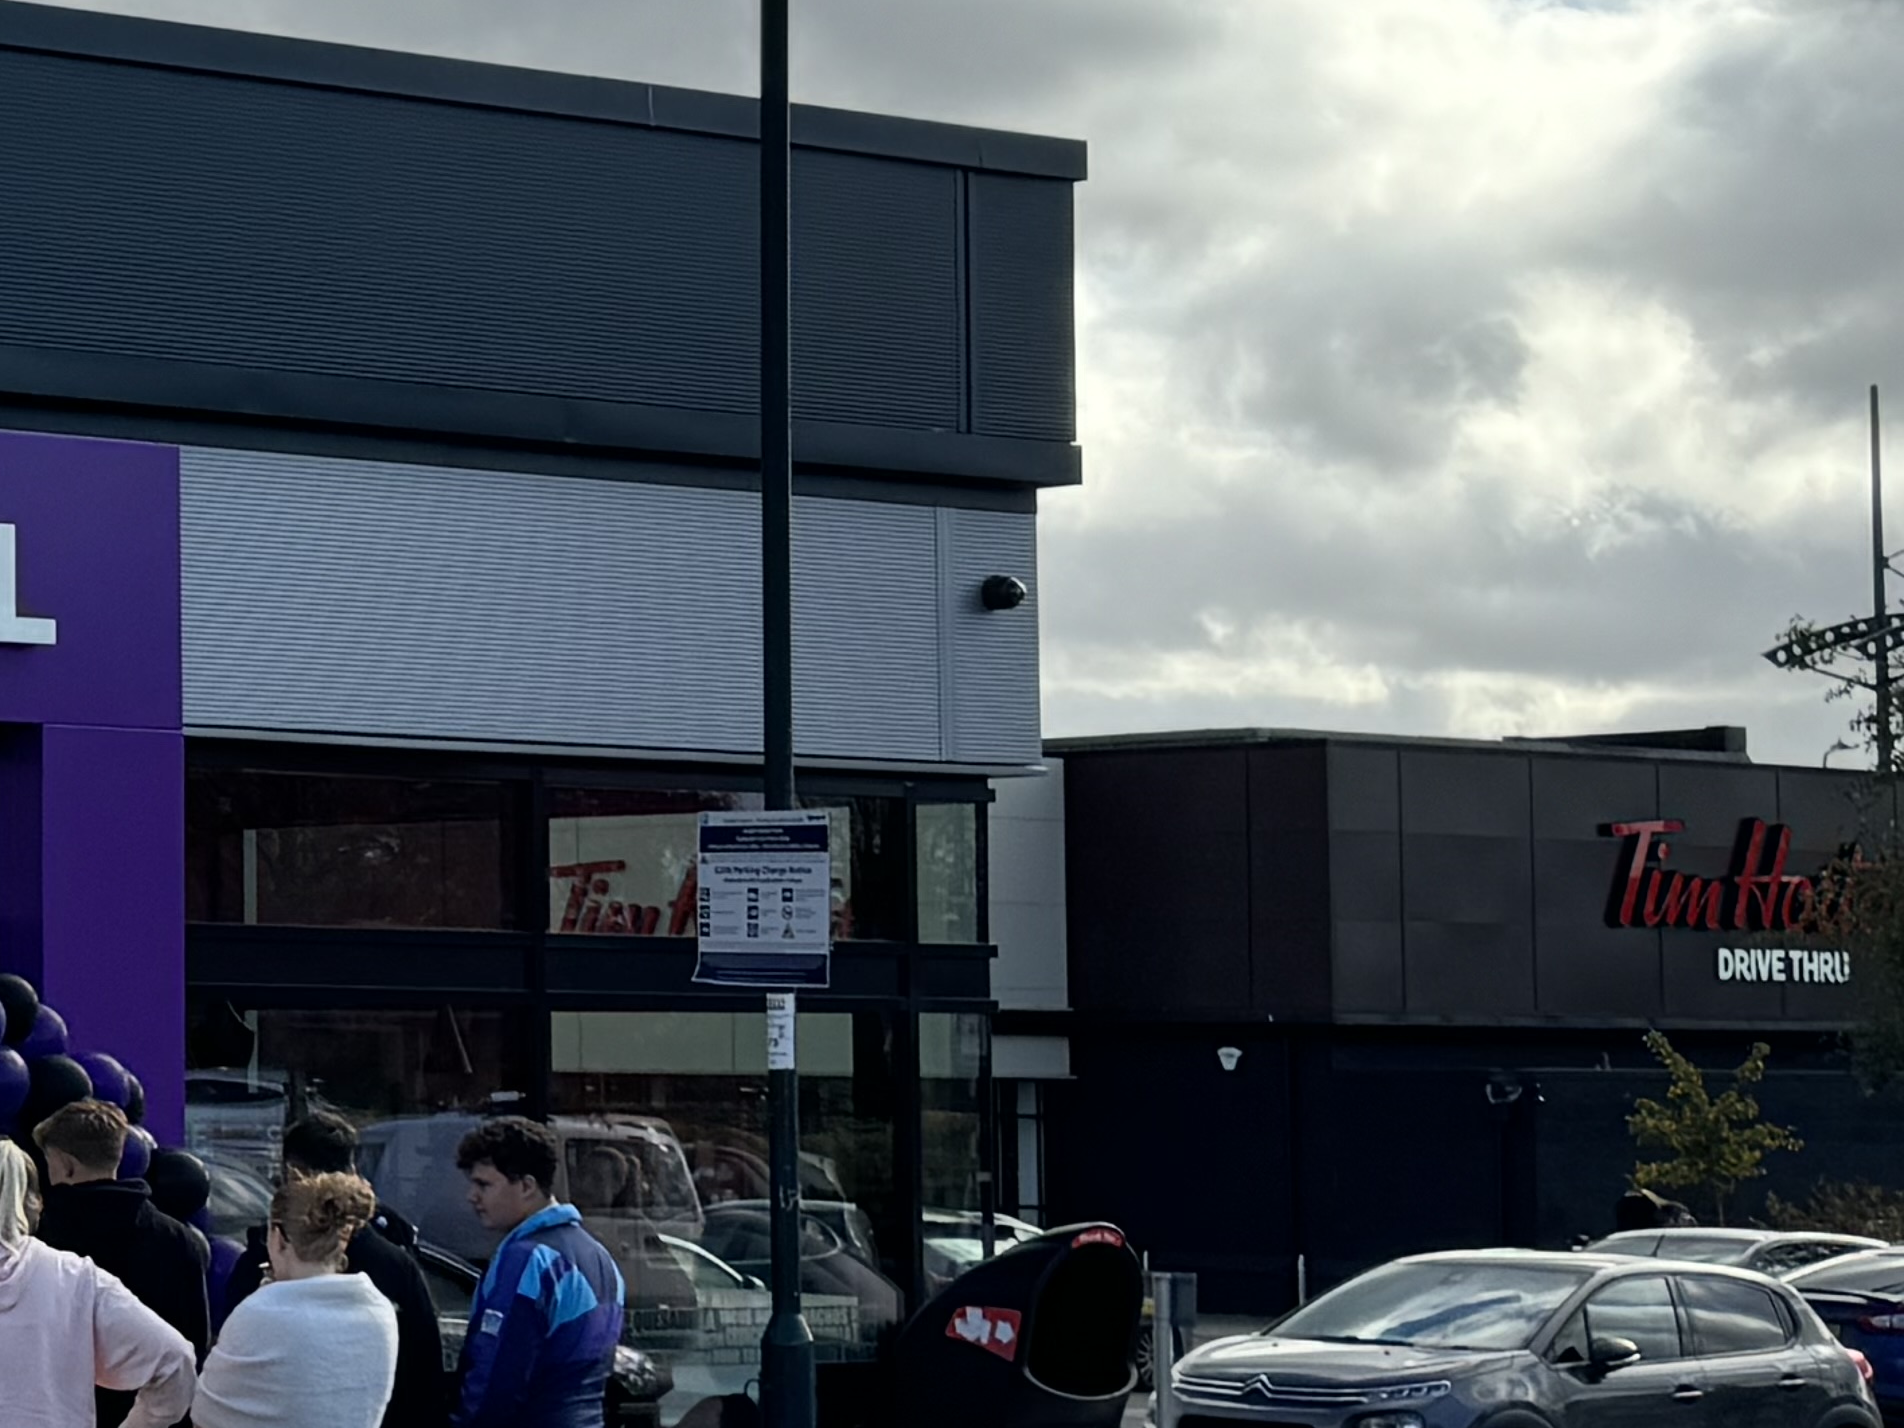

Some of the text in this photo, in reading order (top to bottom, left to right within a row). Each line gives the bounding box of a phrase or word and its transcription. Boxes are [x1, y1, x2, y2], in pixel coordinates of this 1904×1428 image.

[1605, 818, 1723, 931] Tim
[1717, 947, 1850, 984] DRIVE THRU
